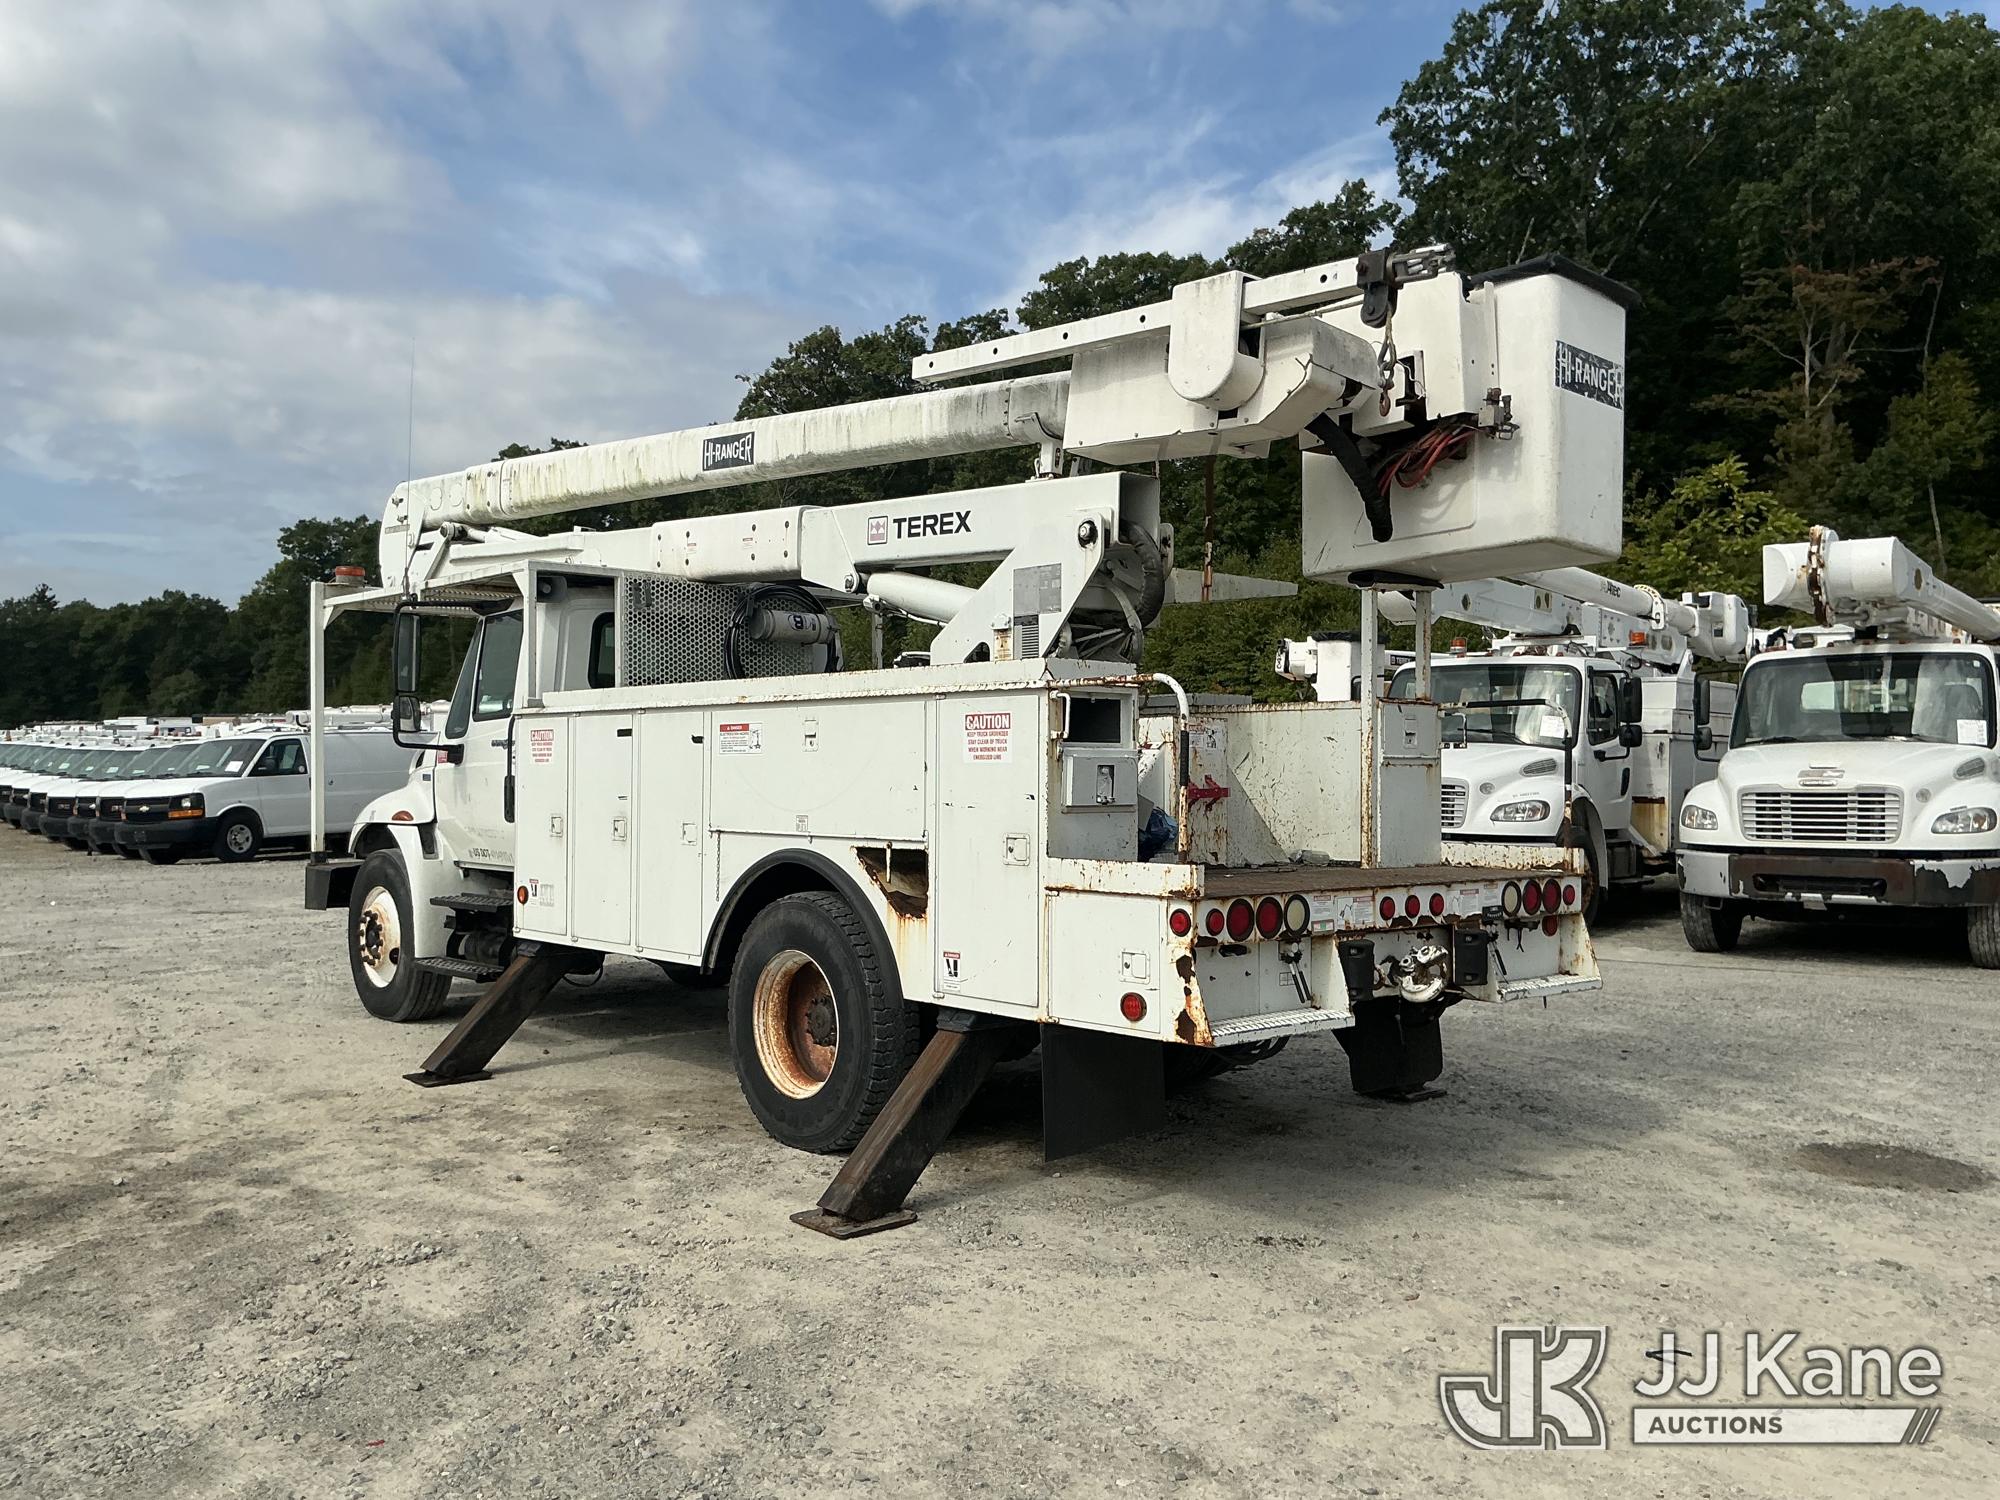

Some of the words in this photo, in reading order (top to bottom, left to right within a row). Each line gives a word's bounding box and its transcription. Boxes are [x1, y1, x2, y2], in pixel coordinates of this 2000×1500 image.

[1557, 342, 1623, 405] HI-RANGER
[703, 433, 752, 470] HI-RANGER
[893, 510, 972, 539] TEREX
[530, 730, 554, 741] CAUTION
[965, 714, 1010, 730] CAUTION
